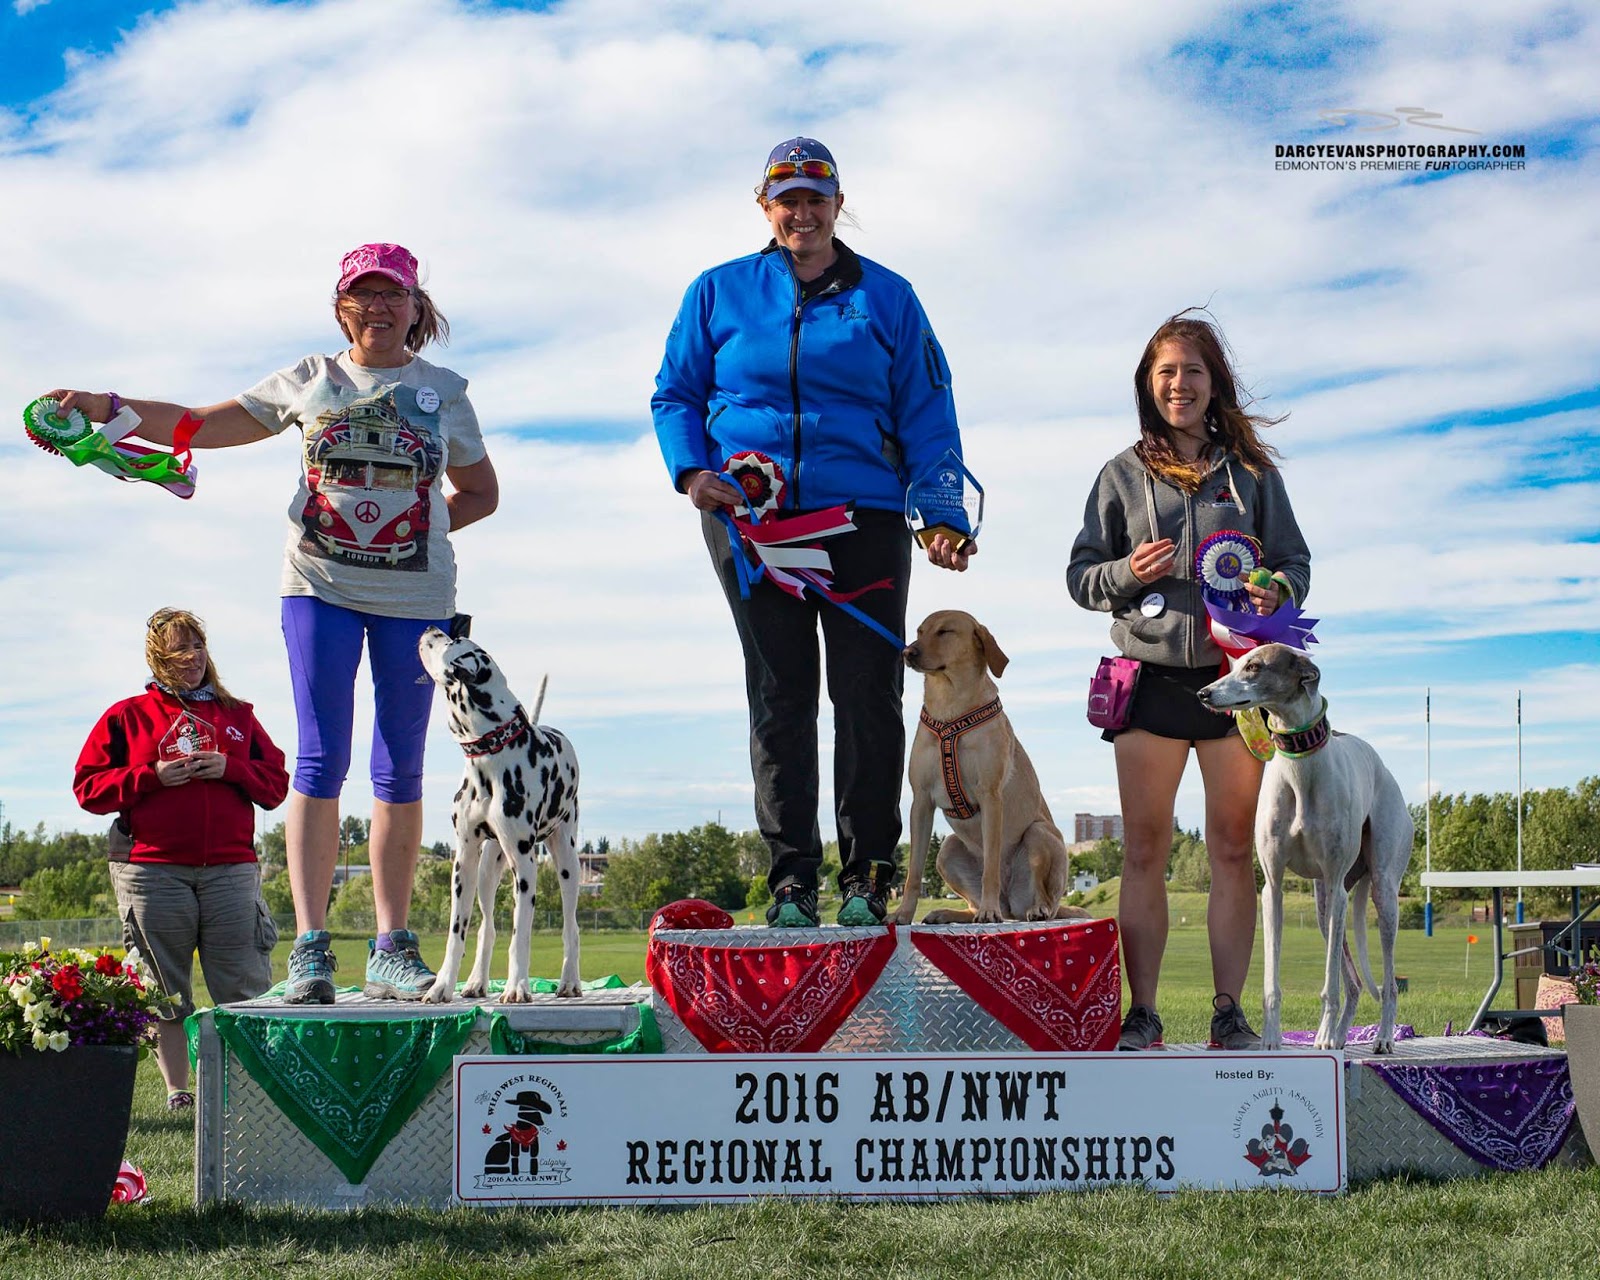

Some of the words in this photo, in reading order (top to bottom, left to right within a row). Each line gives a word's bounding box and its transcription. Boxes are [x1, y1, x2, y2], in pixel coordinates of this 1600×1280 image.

[346, 551, 380, 563] LONDON
[1215, 1069, 1253, 1080] Hosted
[1257, 1069, 1275, 1081] By:
[487, 1089, 502, 1116] WILD
[500, 1074, 525, 1091] WEST
[528, 1074, 568, 1118] REGIONALS
[735, 1071, 839, 1125] 2016
[870, 1070, 1066, 1123] AB/NWT
[1252, 1086, 1285, 1102] AGILITY
[1288, 1089, 1325, 1139] ASSOCIATION
[539, 1158, 568, 1168] Calgary
[626, 1139, 832, 1185] REGIONAL
[854, 1135, 1175, 1183] CHAMPIONSHIPS
[505, 1175, 524, 1183] AAC
